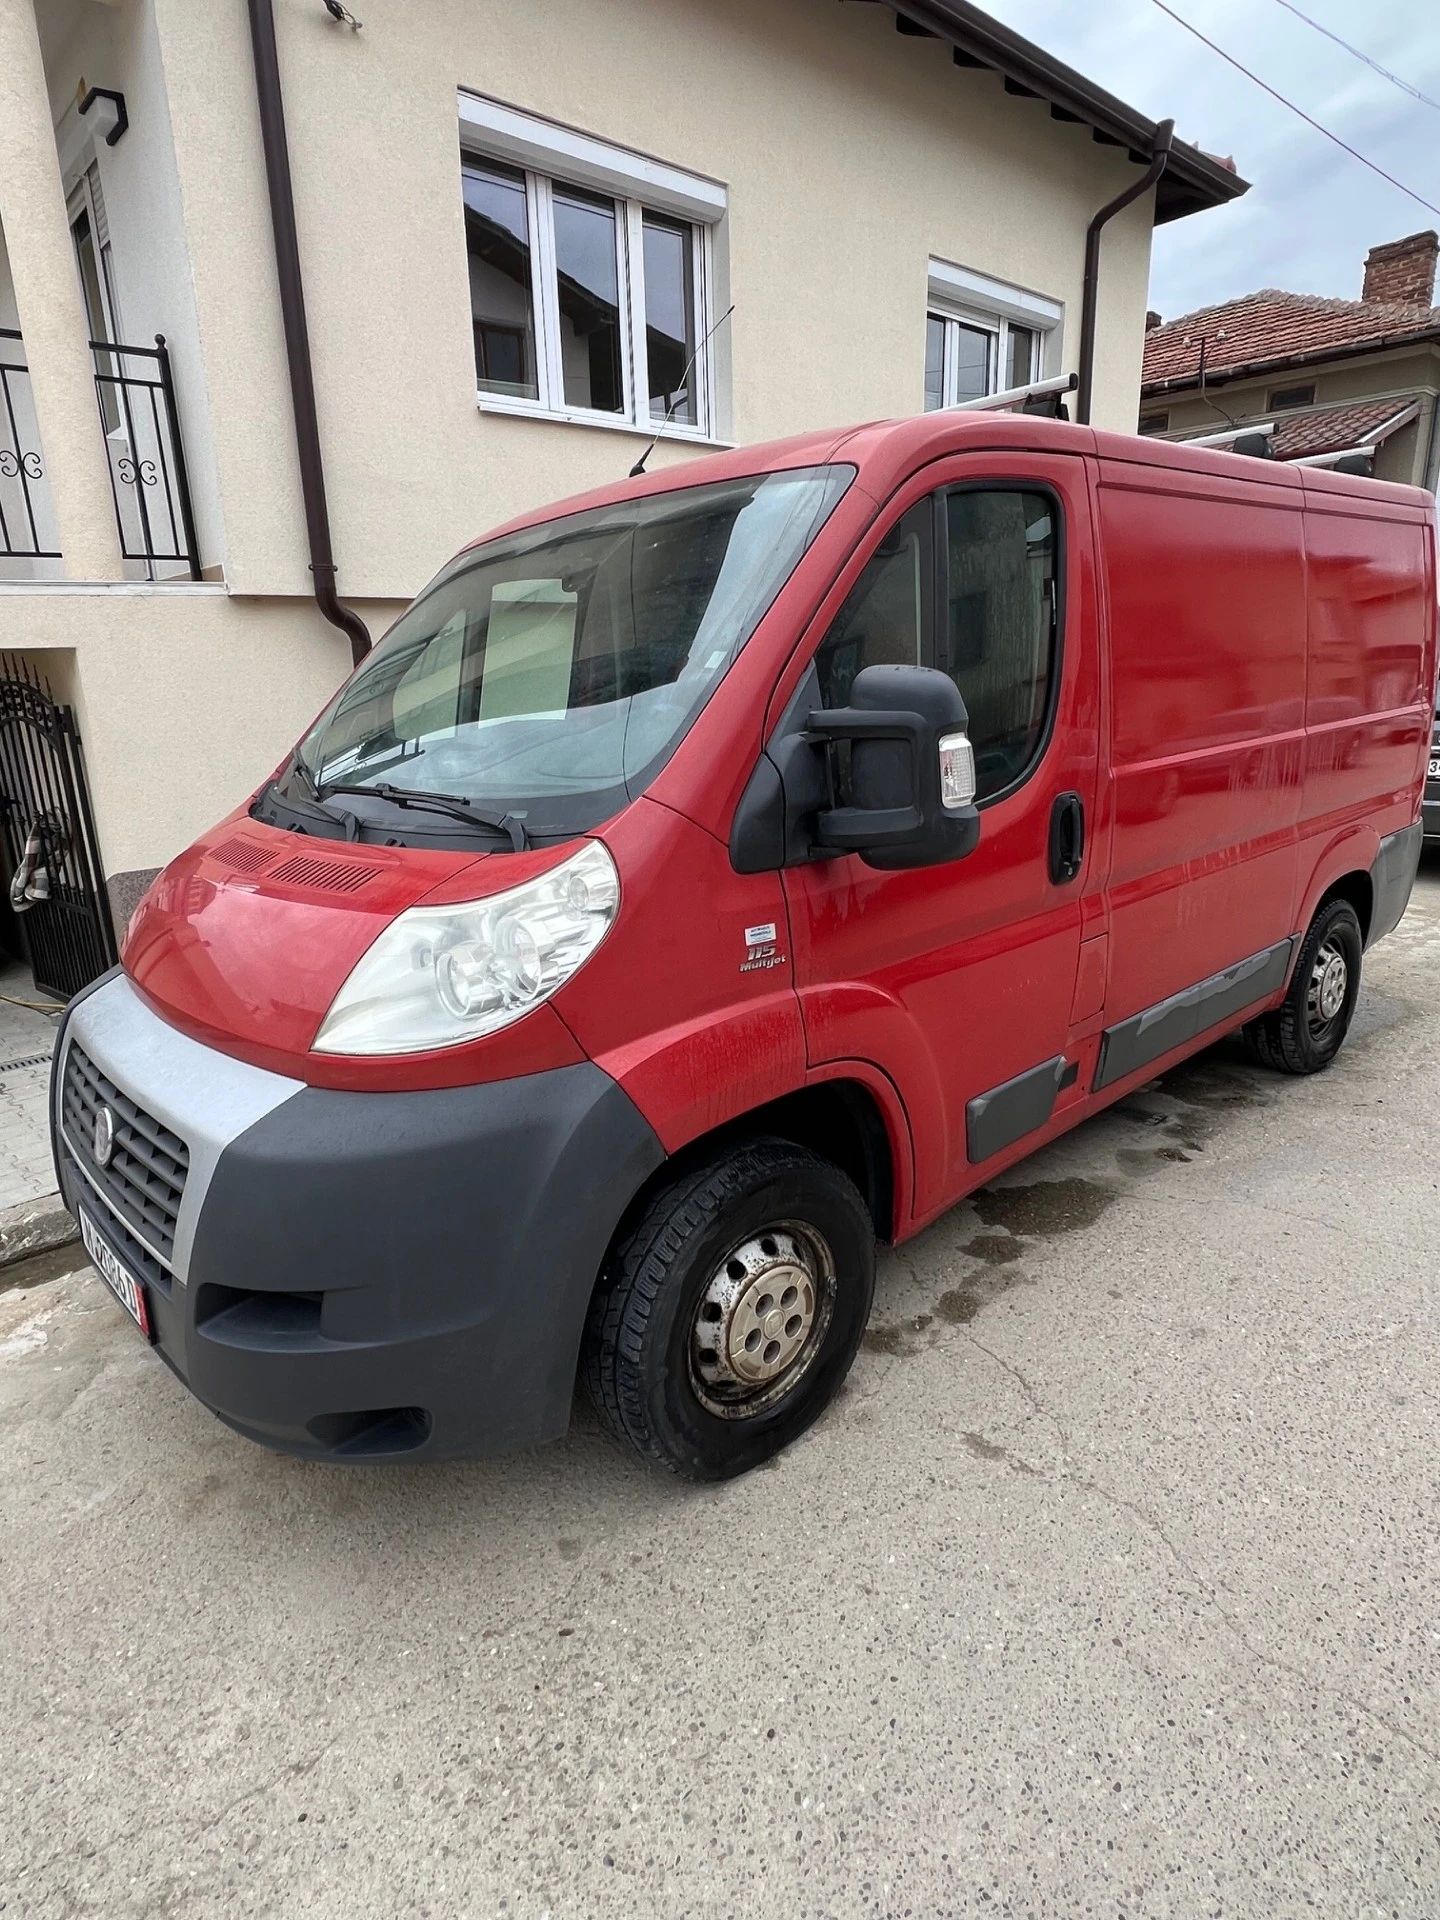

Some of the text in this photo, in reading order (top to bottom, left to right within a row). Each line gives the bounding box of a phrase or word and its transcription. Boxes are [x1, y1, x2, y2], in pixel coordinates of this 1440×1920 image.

[1430, 761, 1440, 773] 3
[747, 944, 776, 961] 115
[739, 954, 786, 972] Multijet
